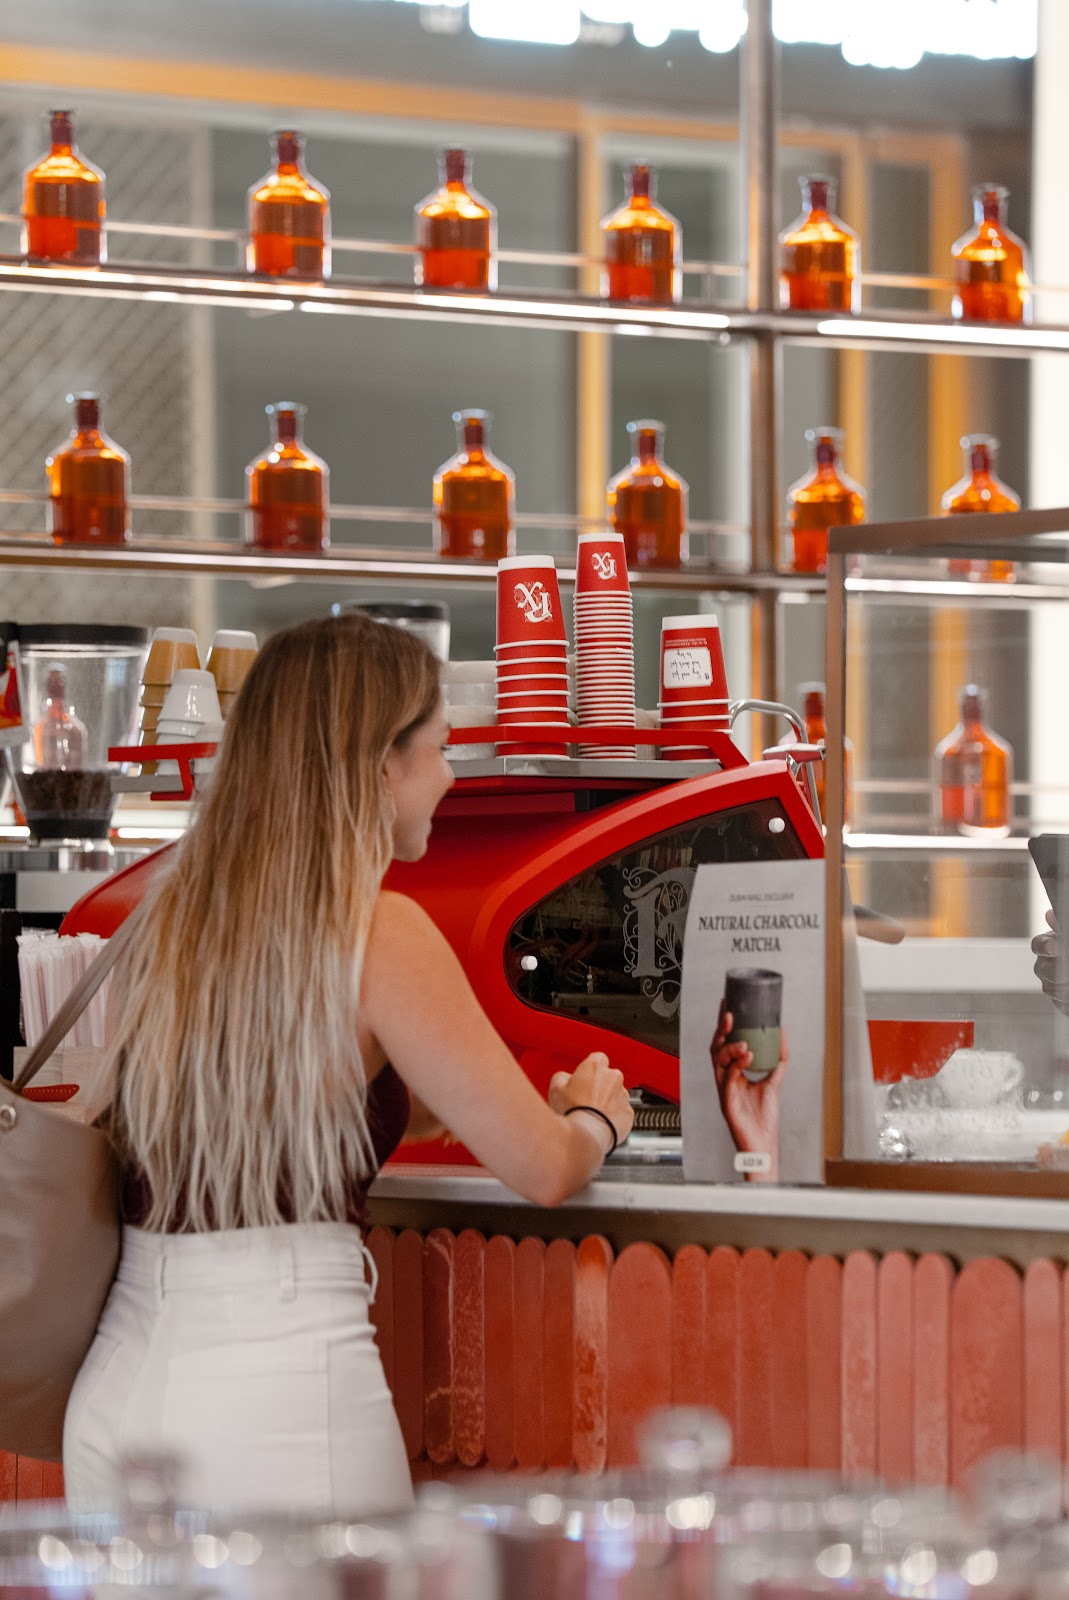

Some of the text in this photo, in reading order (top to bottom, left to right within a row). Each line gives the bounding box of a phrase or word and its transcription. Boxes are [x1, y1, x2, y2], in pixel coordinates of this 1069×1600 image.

[698, 913, 820, 931] NATURAL CHARCOAL
[731, 937, 782, 953] MATCHA
